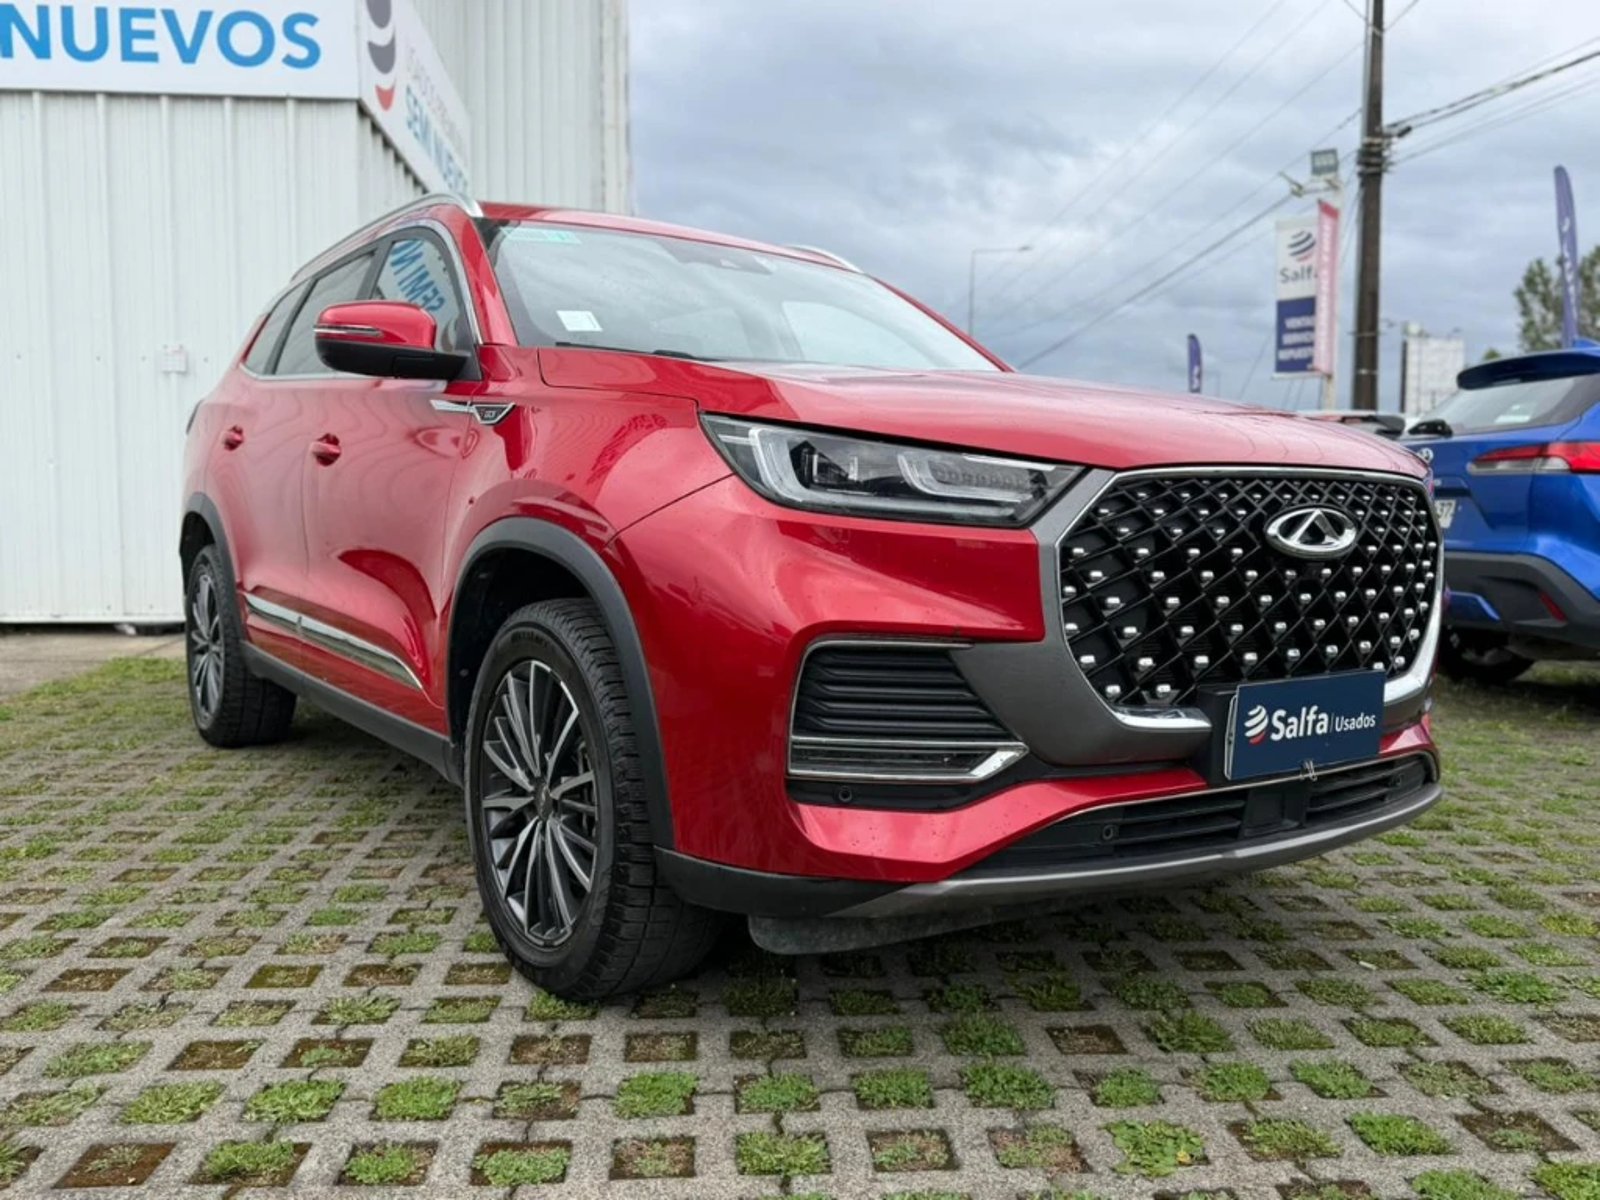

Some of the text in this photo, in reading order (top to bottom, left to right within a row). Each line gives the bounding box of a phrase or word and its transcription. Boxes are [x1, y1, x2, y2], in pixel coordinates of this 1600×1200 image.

[0, 4, 321, 70] NUEVOS
[1270, 705, 1376, 741] Salfa Usados
